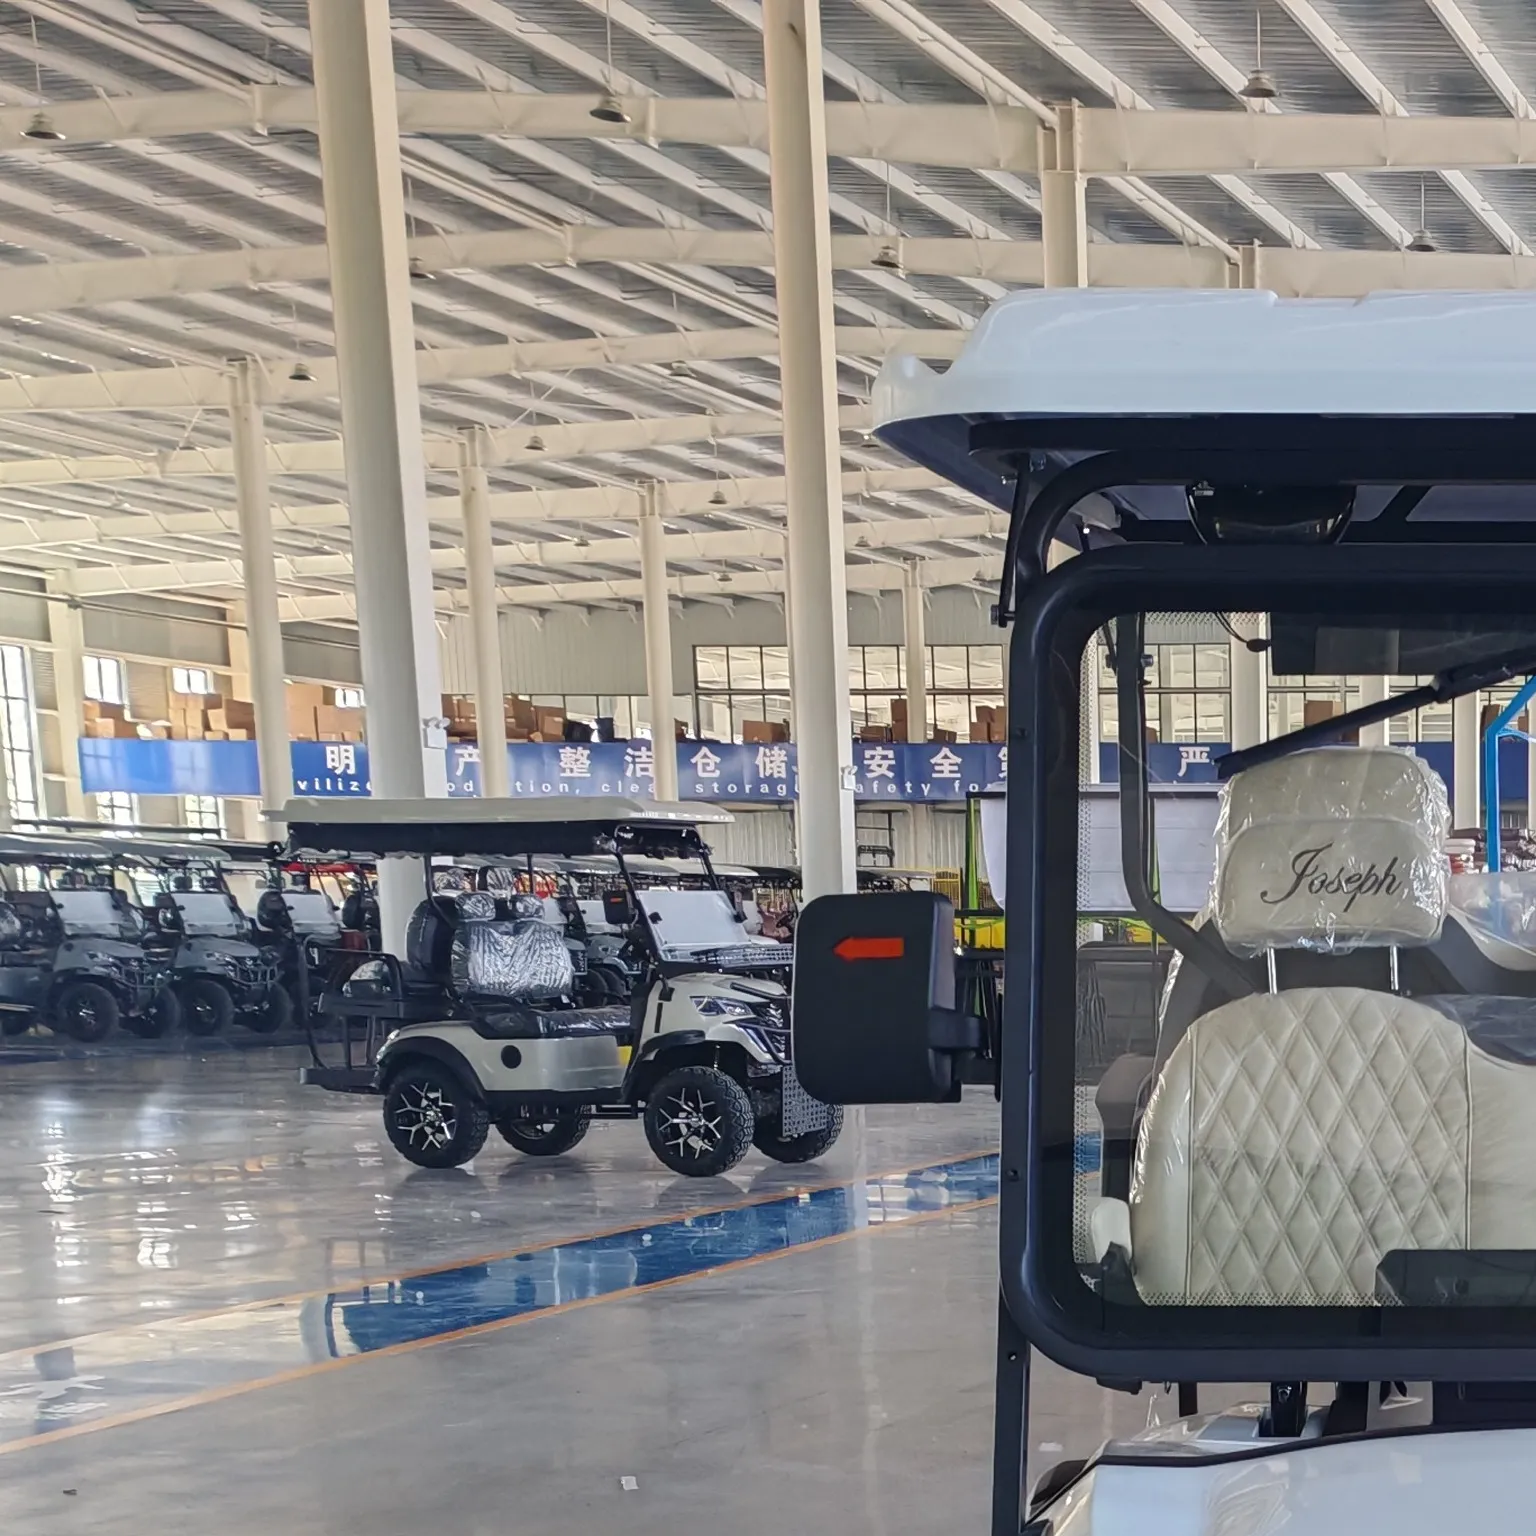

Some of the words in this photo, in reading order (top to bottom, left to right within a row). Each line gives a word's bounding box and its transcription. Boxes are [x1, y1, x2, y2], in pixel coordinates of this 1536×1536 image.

[601, 780, 656, 793] clea
[855, 780, 931, 796] afety
[1260, 842, 1402, 912] Joseph
